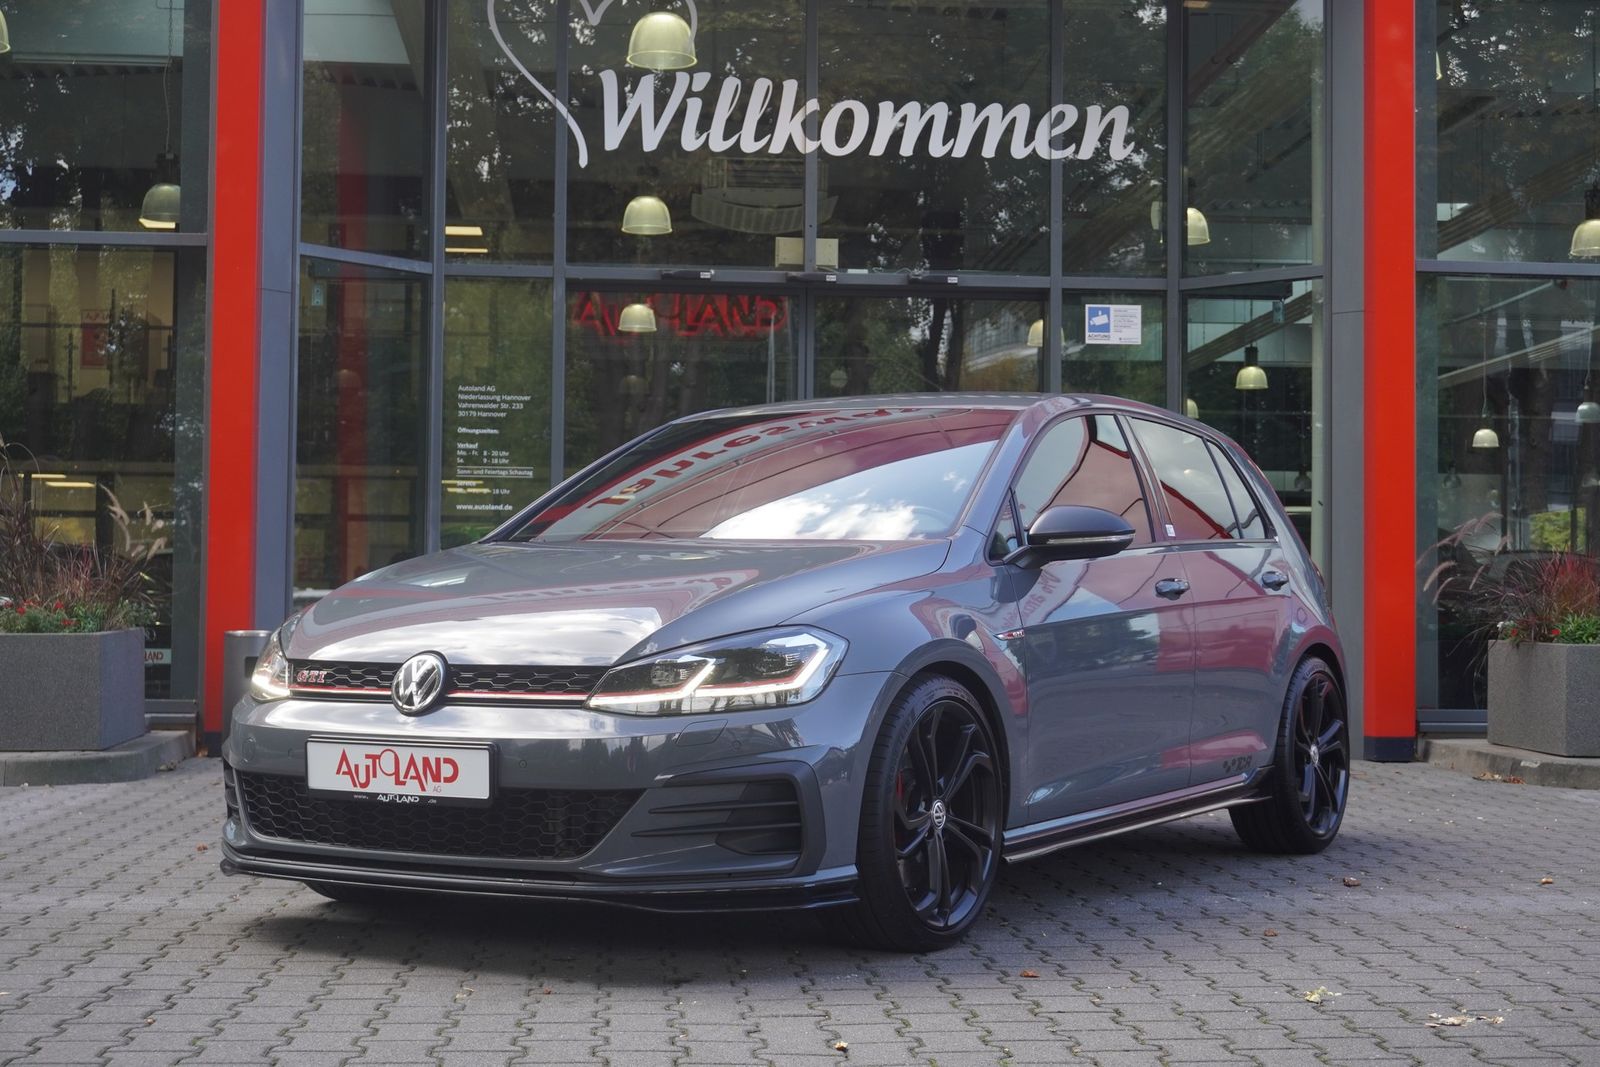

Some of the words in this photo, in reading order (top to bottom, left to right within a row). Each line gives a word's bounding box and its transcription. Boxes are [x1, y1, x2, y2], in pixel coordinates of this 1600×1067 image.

[599, 69, 1136, 161] Willkommen
[457, 394, 501, 402] Niederlassung
[456, 503, 513, 511] www.autoland.de
[296, 669, 328, 683] GTI
[432, 785, 442, 794] AG
